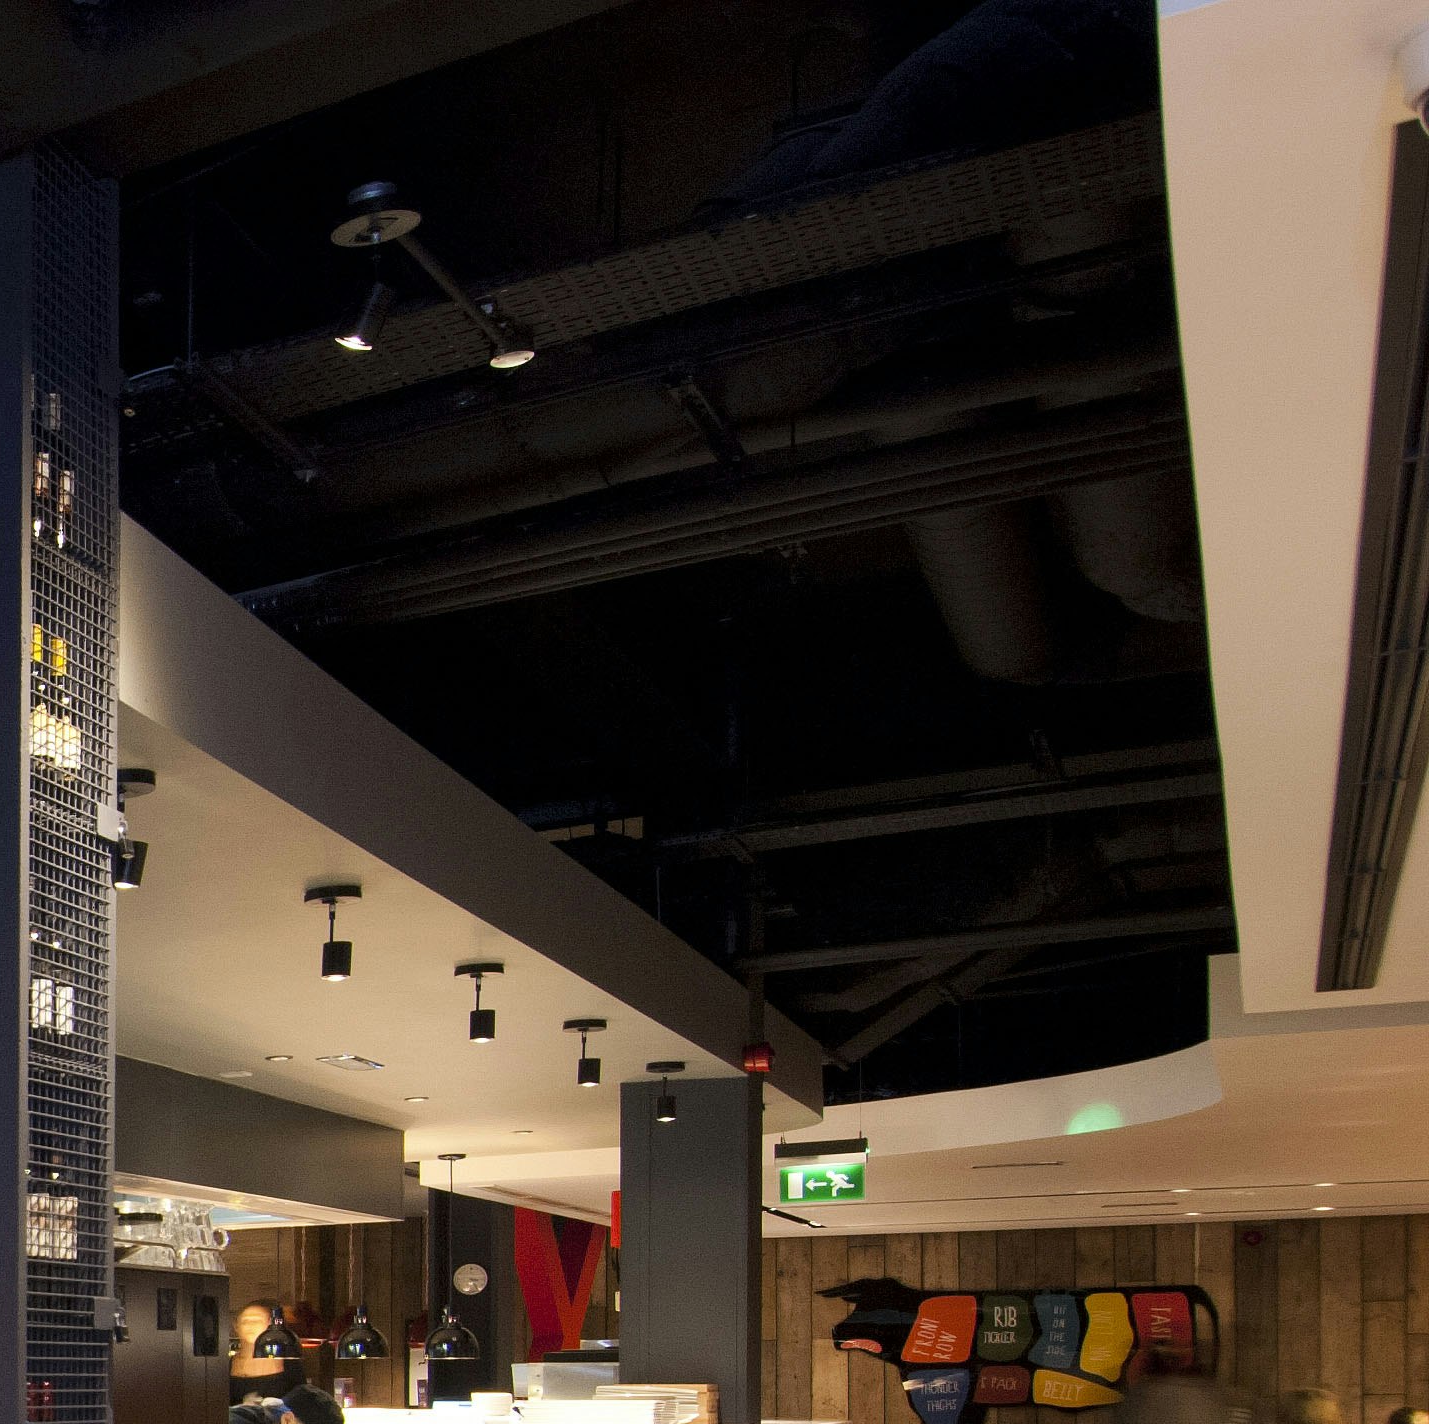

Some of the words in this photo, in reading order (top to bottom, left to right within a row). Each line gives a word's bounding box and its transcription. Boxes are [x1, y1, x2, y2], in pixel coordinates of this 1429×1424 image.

[994, 1306, 1018, 1328] RIB
[912, 1318, 940, 1356] FRONT
[933, 1330, 958, 1360] ROW
[983, 1331, 1016, 1344] TICKLER
[1043, 1379, 1084, 1401] BELLY
